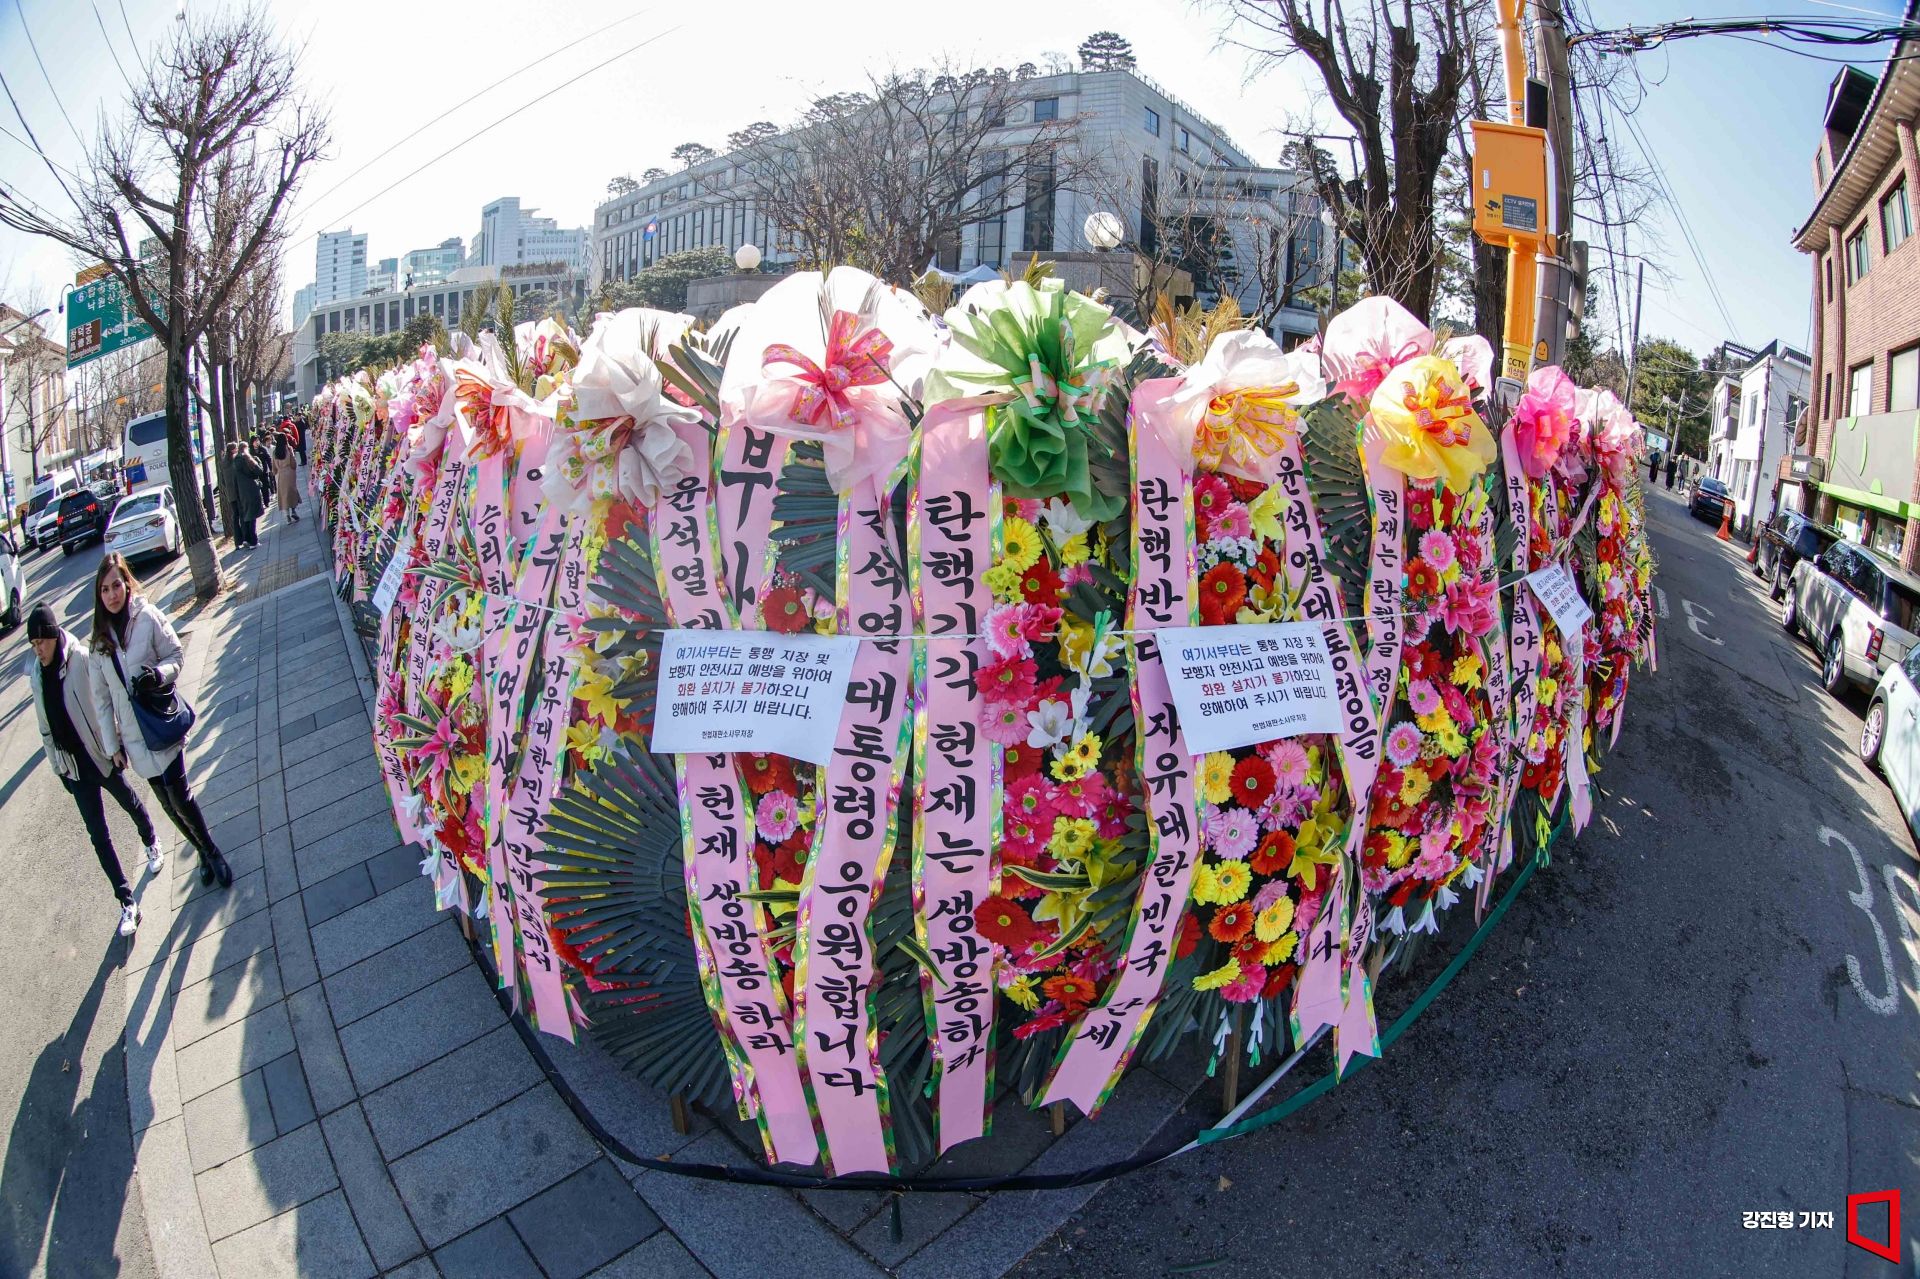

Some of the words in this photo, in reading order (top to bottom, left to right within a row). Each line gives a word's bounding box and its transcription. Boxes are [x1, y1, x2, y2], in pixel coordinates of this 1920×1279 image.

[119, 335, 137, 346] 300m
[1507, 358, 1527, 369] CCTV
[431, 461, 462, 533] 부정선거
[662, 476, 708, 597] 윤석열
[1276, 456, 1324, 582] 윤석열
[1376, 489, 1398, 568] 헌재는
[478, 504, 514, 635] 승리하고
[555, 514, 586, 643] 지합니다
[923, 490, 985, 701] 탄핵기각
[676, 646, 742, 660] 여기서부터는
[749, 646, 775, 661] 통행
[781, 649, 809, 663] 지장
[816, 652, 830, 665] 및
[1182, 643, 1253, 662] 여기서부터는
[1256, 639, 1279, 652] 통행
[1283, 636, 1303, 649] 지장
[1306, 636, 1316, 648] 및
[1372, 579, 1399, 658] 탄핵을
[668, 664, 696, 679] 보행자
[700, 663, 743, 677] 안전사고
[748, 663, 786, 678] 예방을
[792, 666, 833, 684] 위하여
[677, 682, 696, 697] 화환
[701, 681, 735, 695] 설치가
[741, 682, 809, 699] 불가하오니
[1181, 665, 1215, 681] 보행자
[1219, 657, 1264, 676] 안전사고
[1267, 653, 1299, 668] 예방을
[1300, 652, 1325, 665] 위하여
[1199, 696, 1249, 717] 양해하여
[1254, 688, 1290, 707] 주시기
[1201, 682, 1226, 697] 화환
[1231, 675, 1268, 693] 설치가
[1272, 668, 1321, 685] 불가하오니
[511, 656, 569, 835] 자유대한민국
[671, 701, 707, 718] 양해하여
[712, 700, 747, 715] 주시기
[753, 700, 812, 720] 바랍니다.
[832, 671, 897, 840] 대통령
[696, 784, 737, 864] 헌재
[925, 720, 985, 874] 헌재는
[1130, 702, 1189, 977] 자유대한민국
[814, 860, 877, 1097] 응원합니다
[928, 889, 990, 1076] 생방송하라
